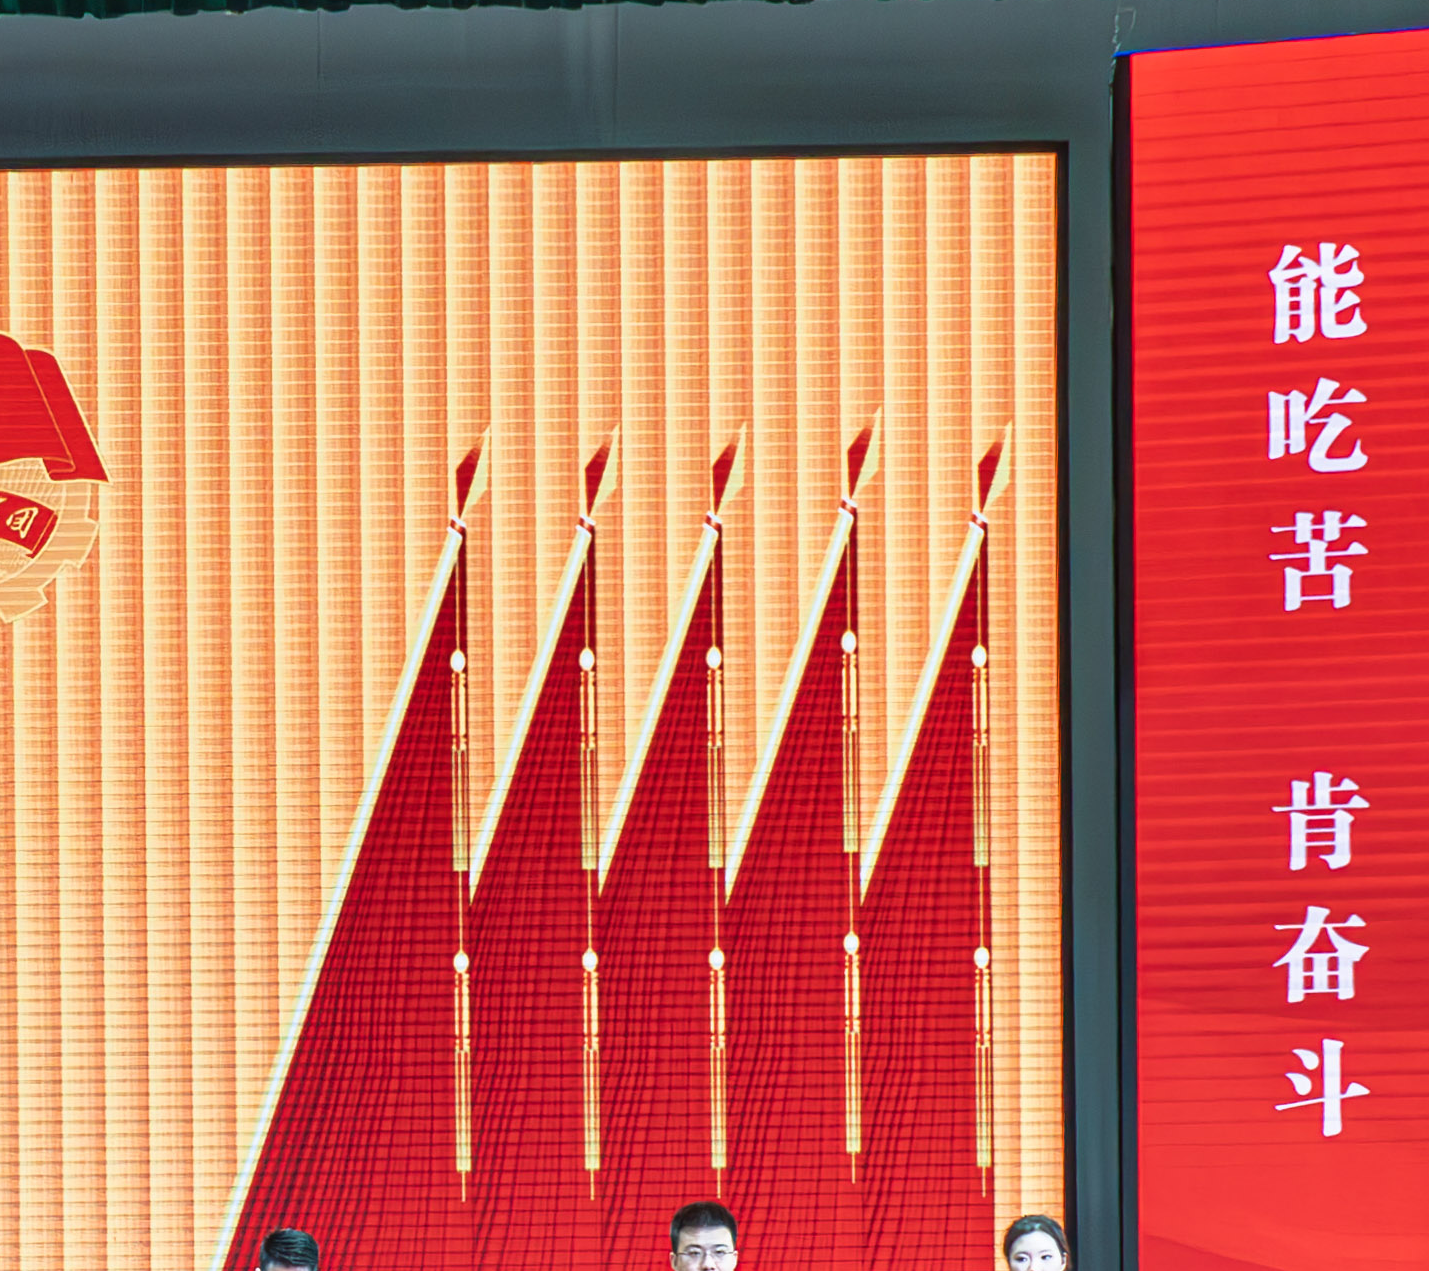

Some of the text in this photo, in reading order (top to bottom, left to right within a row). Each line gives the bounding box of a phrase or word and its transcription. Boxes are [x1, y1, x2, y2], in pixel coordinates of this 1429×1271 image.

[1268, 242, 1370, 1137] 能吃苦 肯奋斗
